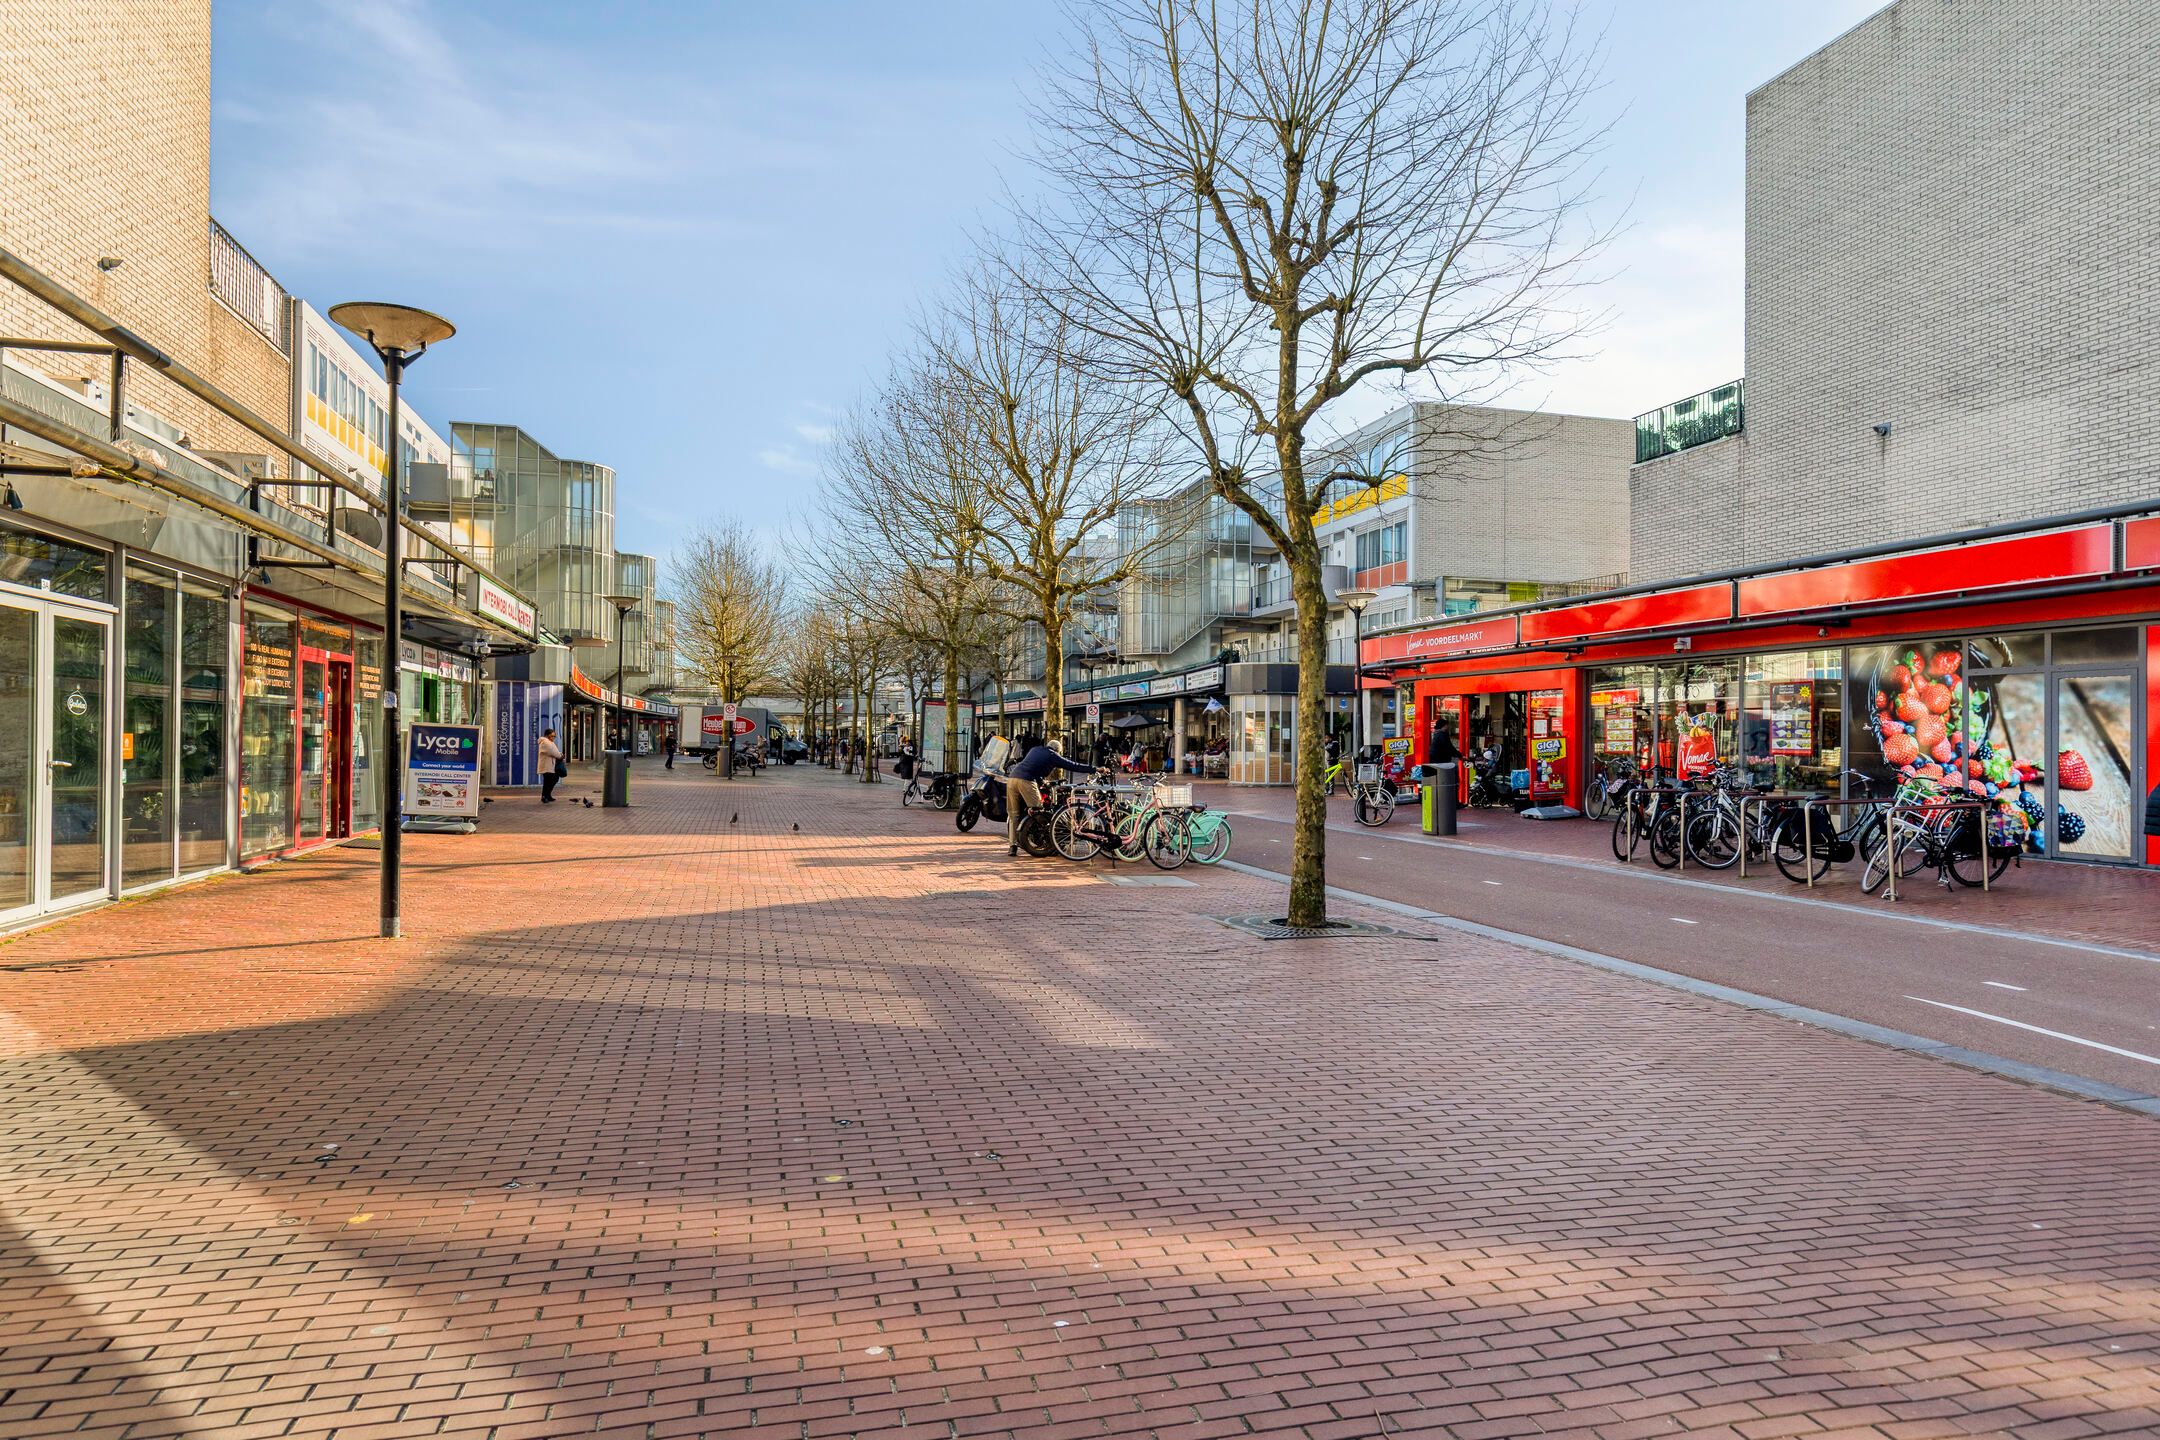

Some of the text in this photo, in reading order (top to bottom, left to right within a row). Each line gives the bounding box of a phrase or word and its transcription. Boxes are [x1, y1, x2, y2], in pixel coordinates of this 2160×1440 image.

[483, 589, 532, 628] INTERMOBI CALL CENTER
[1425, 631, 1484, 647] VOORDEELMARKT
[417, 733, 460, 749] Lyca
[1389, 740, 1408, 750] GIGA
[1537, 740, 1560, 750] GIGA
[1681, 744, 1714, 770] Vomar
